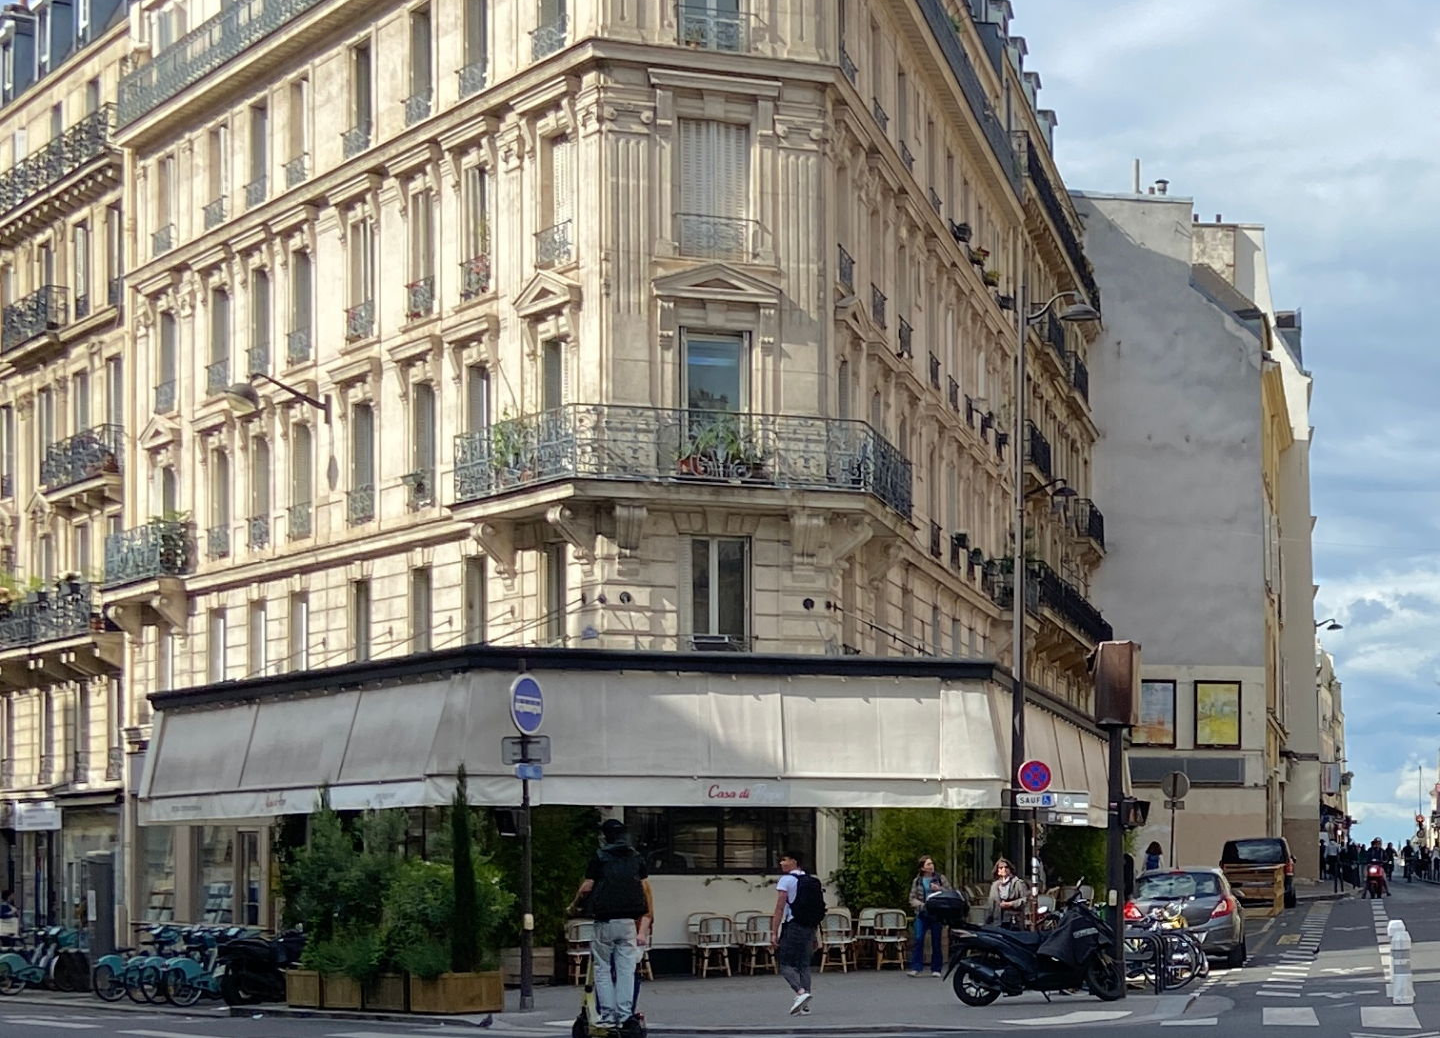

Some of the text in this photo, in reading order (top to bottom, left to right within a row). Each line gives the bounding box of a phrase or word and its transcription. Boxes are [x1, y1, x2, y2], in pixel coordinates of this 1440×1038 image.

[708, 784, 736, 799] Casa
[739, 788, 750, 799] di
[1020, 796, 1041, 804] SAUF
